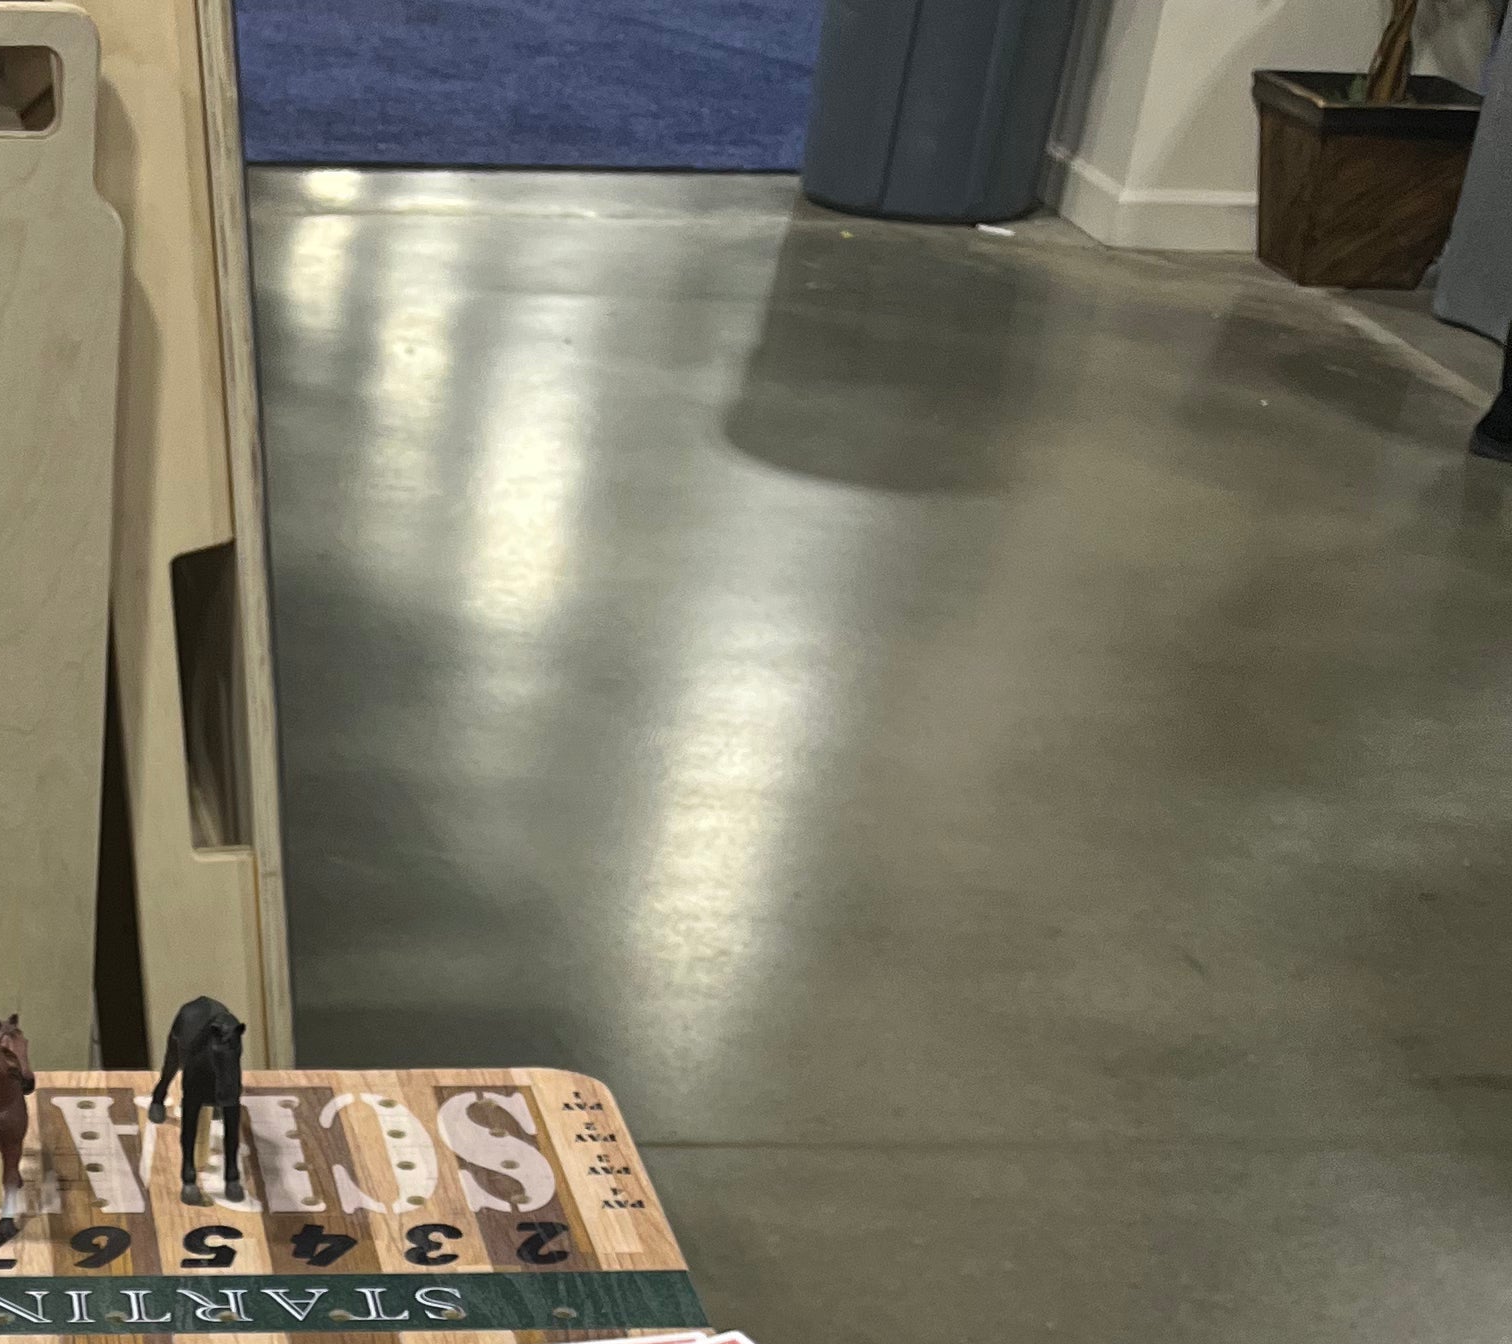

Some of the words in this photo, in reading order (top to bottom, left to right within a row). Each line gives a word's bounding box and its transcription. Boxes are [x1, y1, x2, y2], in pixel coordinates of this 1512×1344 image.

[561, 1102, 603, 1111] PAY
[574, 1133, 616, 1142] PAY
[588, 1166, 631, 1175] PAY
[601, 1199, 645, 1209] PAY
[70, 1226, 132, 1269] 6
[180, 1225, 243, 1269] 5
[291, 1223, 357, 1267] 4
[403, 1223, 463, 1267] 3
[515, 1221, 572, 1266] 2
